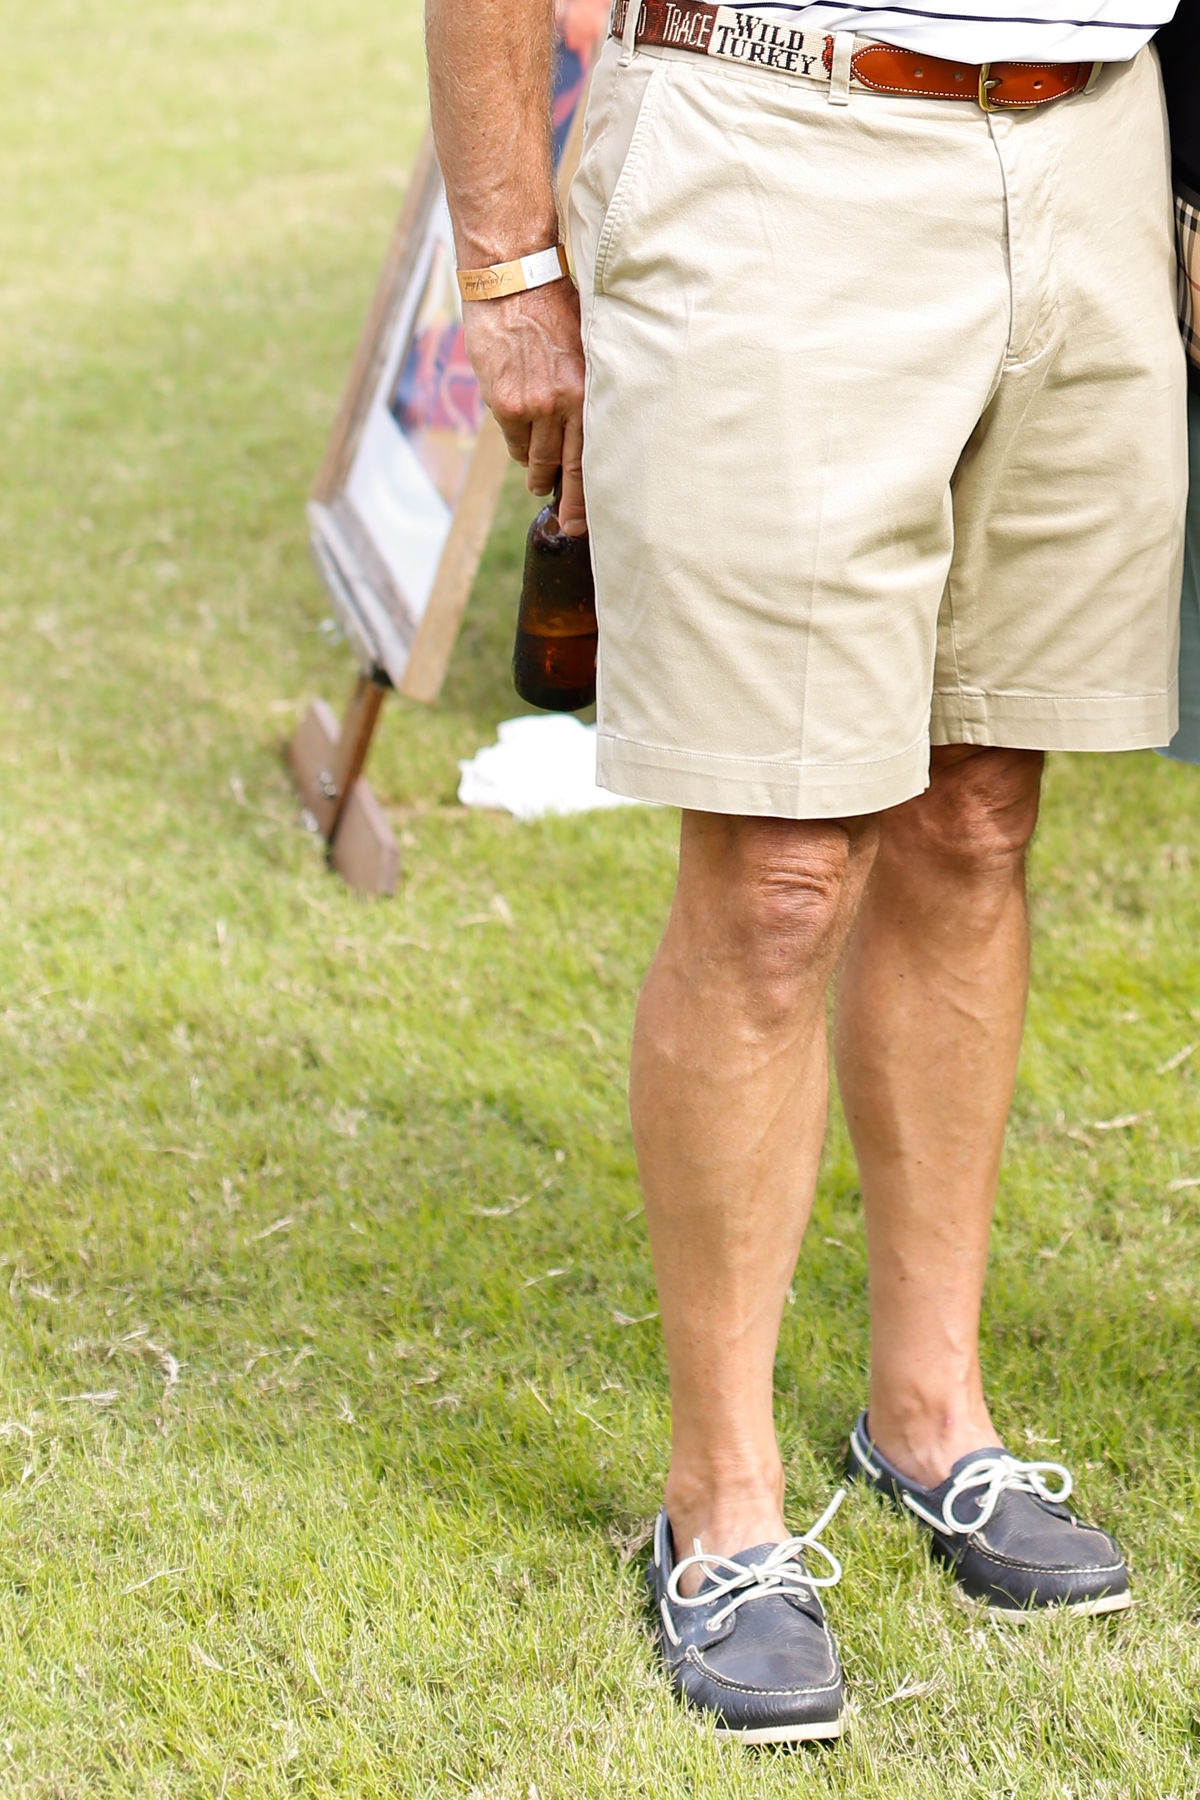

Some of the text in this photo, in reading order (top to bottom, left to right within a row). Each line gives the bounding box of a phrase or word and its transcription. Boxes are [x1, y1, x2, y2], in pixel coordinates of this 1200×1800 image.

[662, 2, 713, 48] TRACE
[735, 12, 805, 51] WILD
[716, 25, 818, 75] TURKEY
